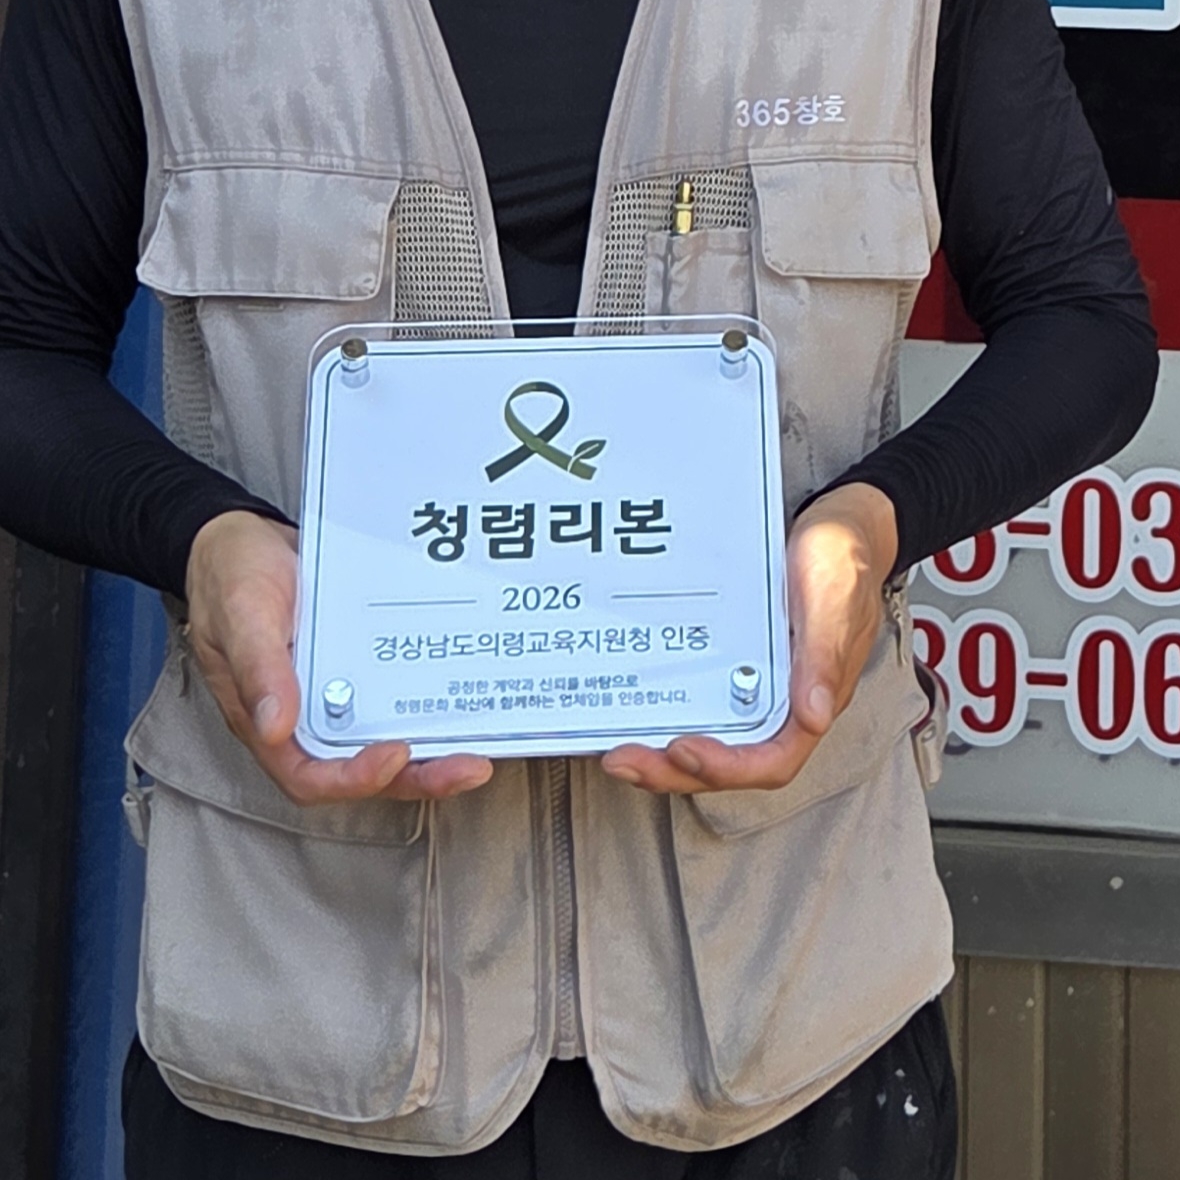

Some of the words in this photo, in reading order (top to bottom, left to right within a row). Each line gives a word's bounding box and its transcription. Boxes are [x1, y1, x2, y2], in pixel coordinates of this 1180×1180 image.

[735, 94, 847, 128] 365창호
[411, 498, 673, 563] 청렴리본
[501, 583, 583, 613] 2026
[372, 625, 652, 662] 경상남도의령교육지원청
[660, 624, 711, 652] 인증
[447, 679, 489, 696] 공정한
[492, 677, 535, 693] 계약과
[584, 673, 639, 690] 바탕으로
